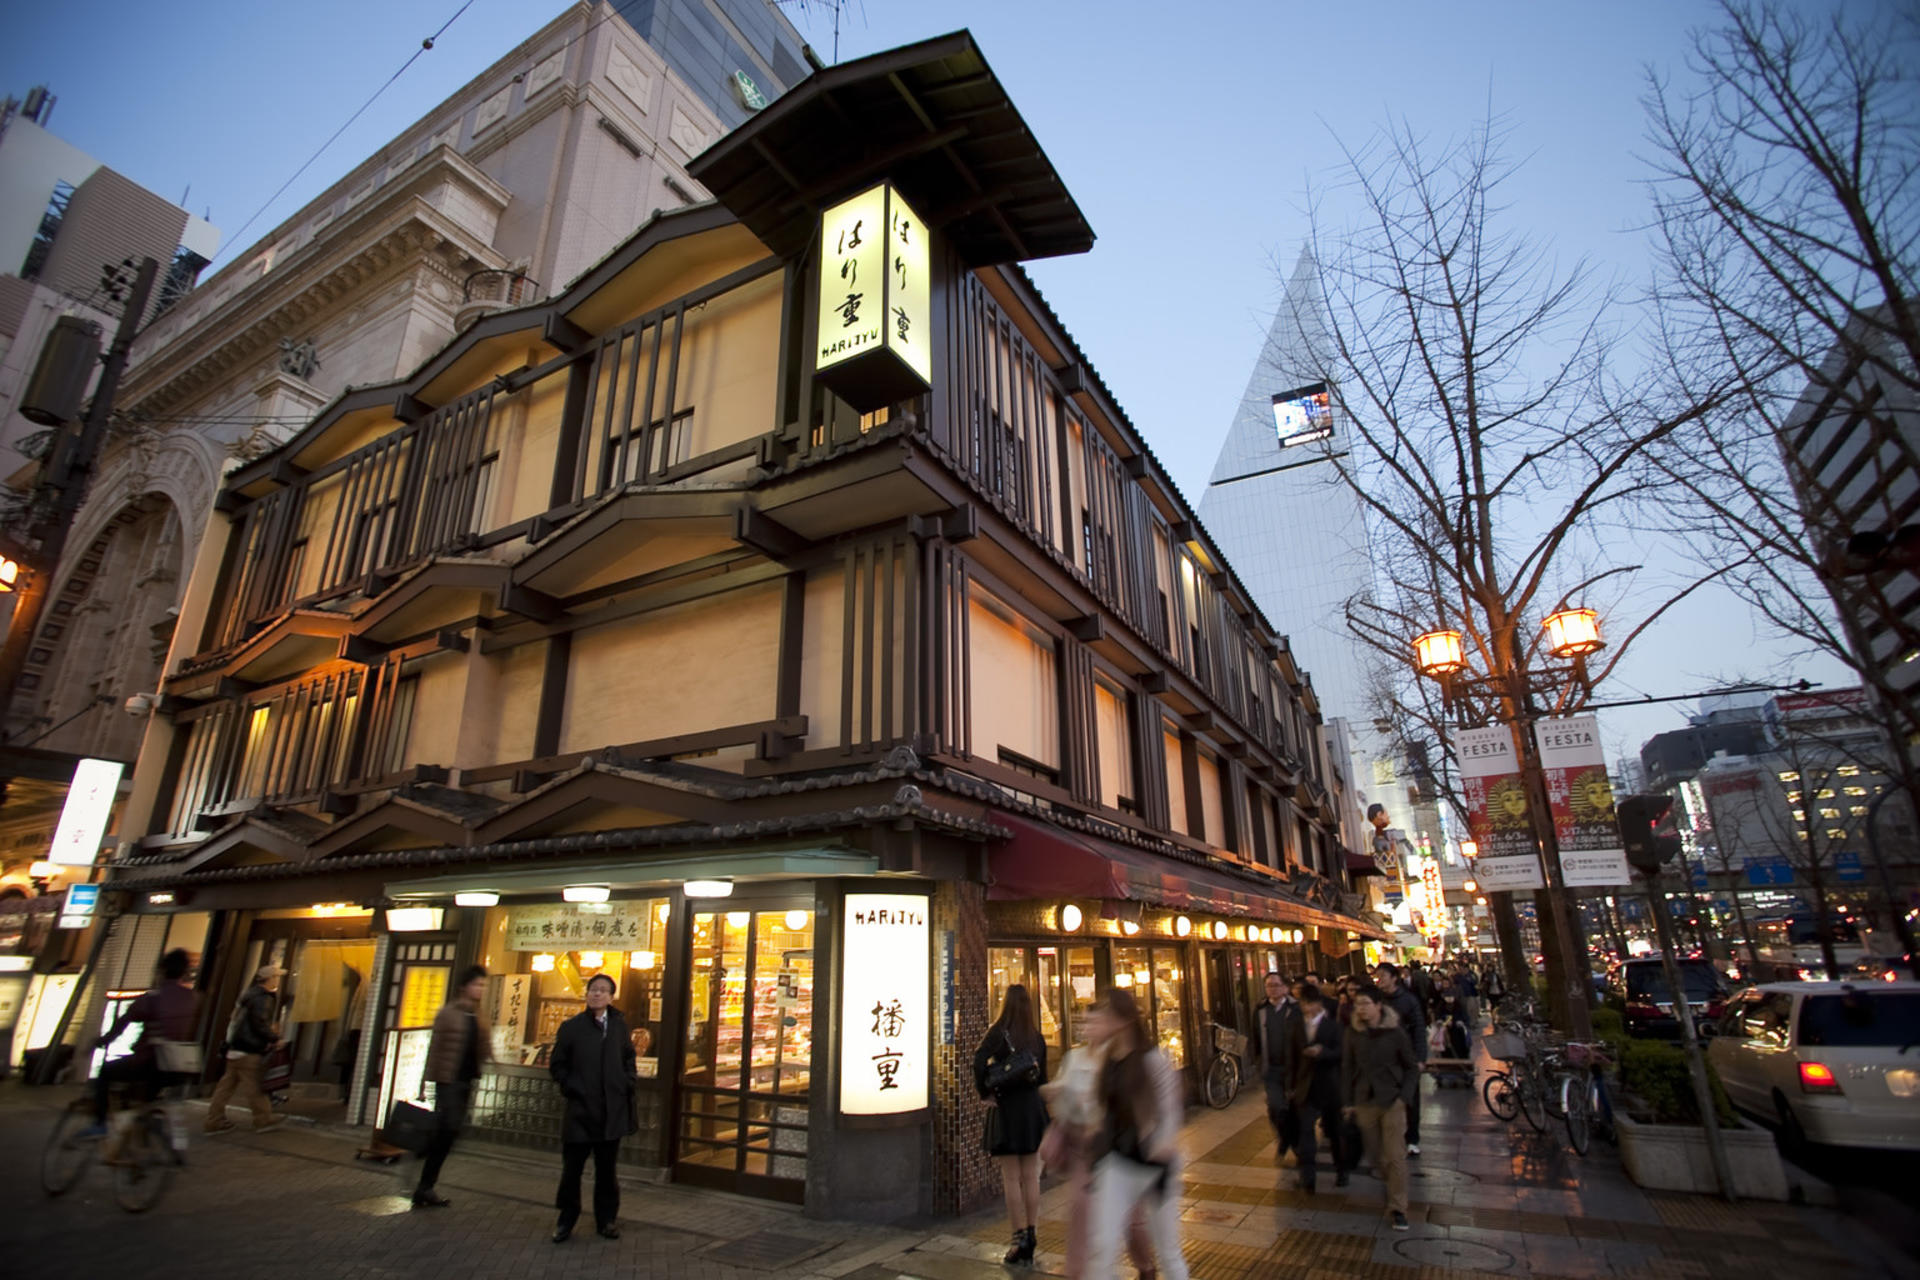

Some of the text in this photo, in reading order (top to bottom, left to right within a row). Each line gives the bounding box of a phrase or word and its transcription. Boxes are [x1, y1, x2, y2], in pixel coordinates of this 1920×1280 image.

[835, 219, 863, 328] はり重
[821, 327, 879, 359] HARIJYU
[1544, 732, 1593, 747] FESTA
[1463, 742, 1508, 757] FESTA
[855, 909, 923, 926] HARIJYU
